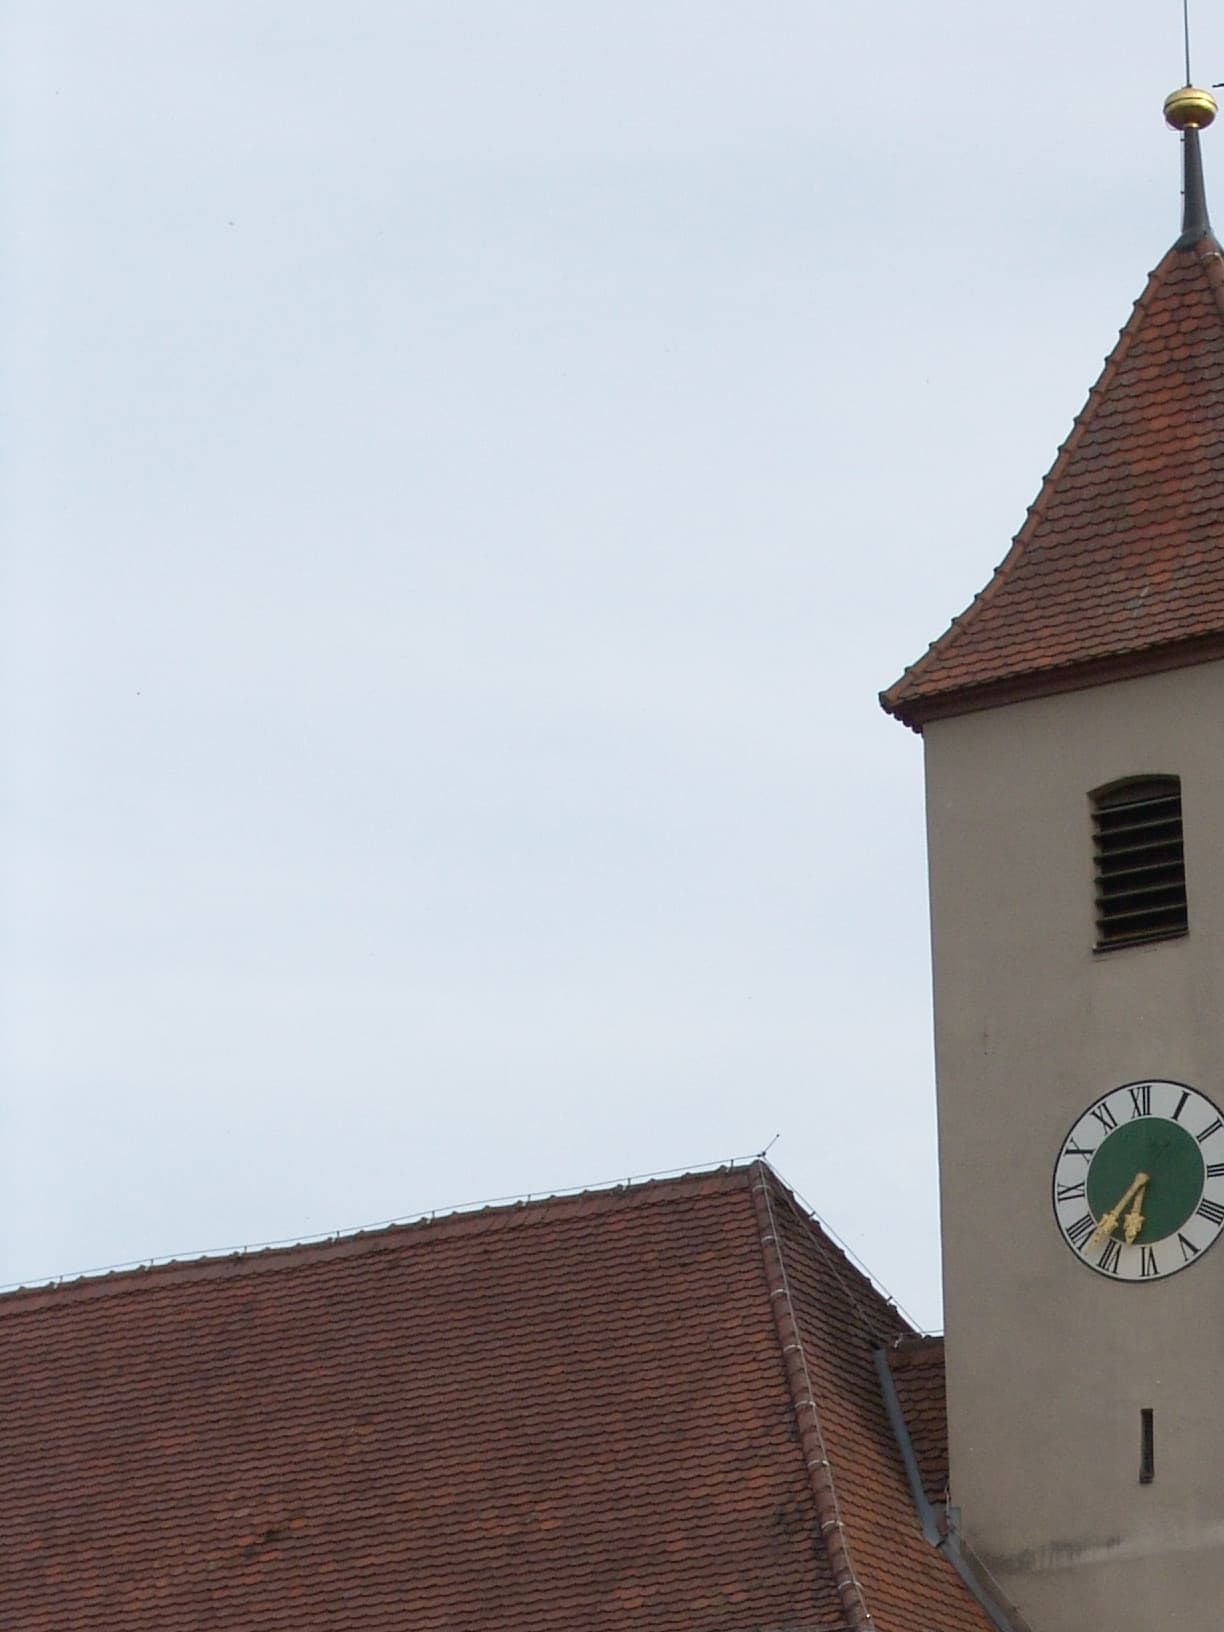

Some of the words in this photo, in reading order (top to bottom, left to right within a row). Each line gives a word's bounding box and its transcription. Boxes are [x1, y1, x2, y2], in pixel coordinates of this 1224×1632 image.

[1129, 1085, 1152, 1119] XII
[1171, 1090, 1191, 1121] I
[1091, 1101, 1118, 1135] XI
[1196, 1117, 1224, 1142] II
[1063, 1137, 1095, 1164] X
[1057, 1182, 1086, 1202] IX
[1097, 1239, 1122, 1274] VII
[1139, 1246, 1160, 1277] VI
[1178, 1233, 1201, 1262] V
